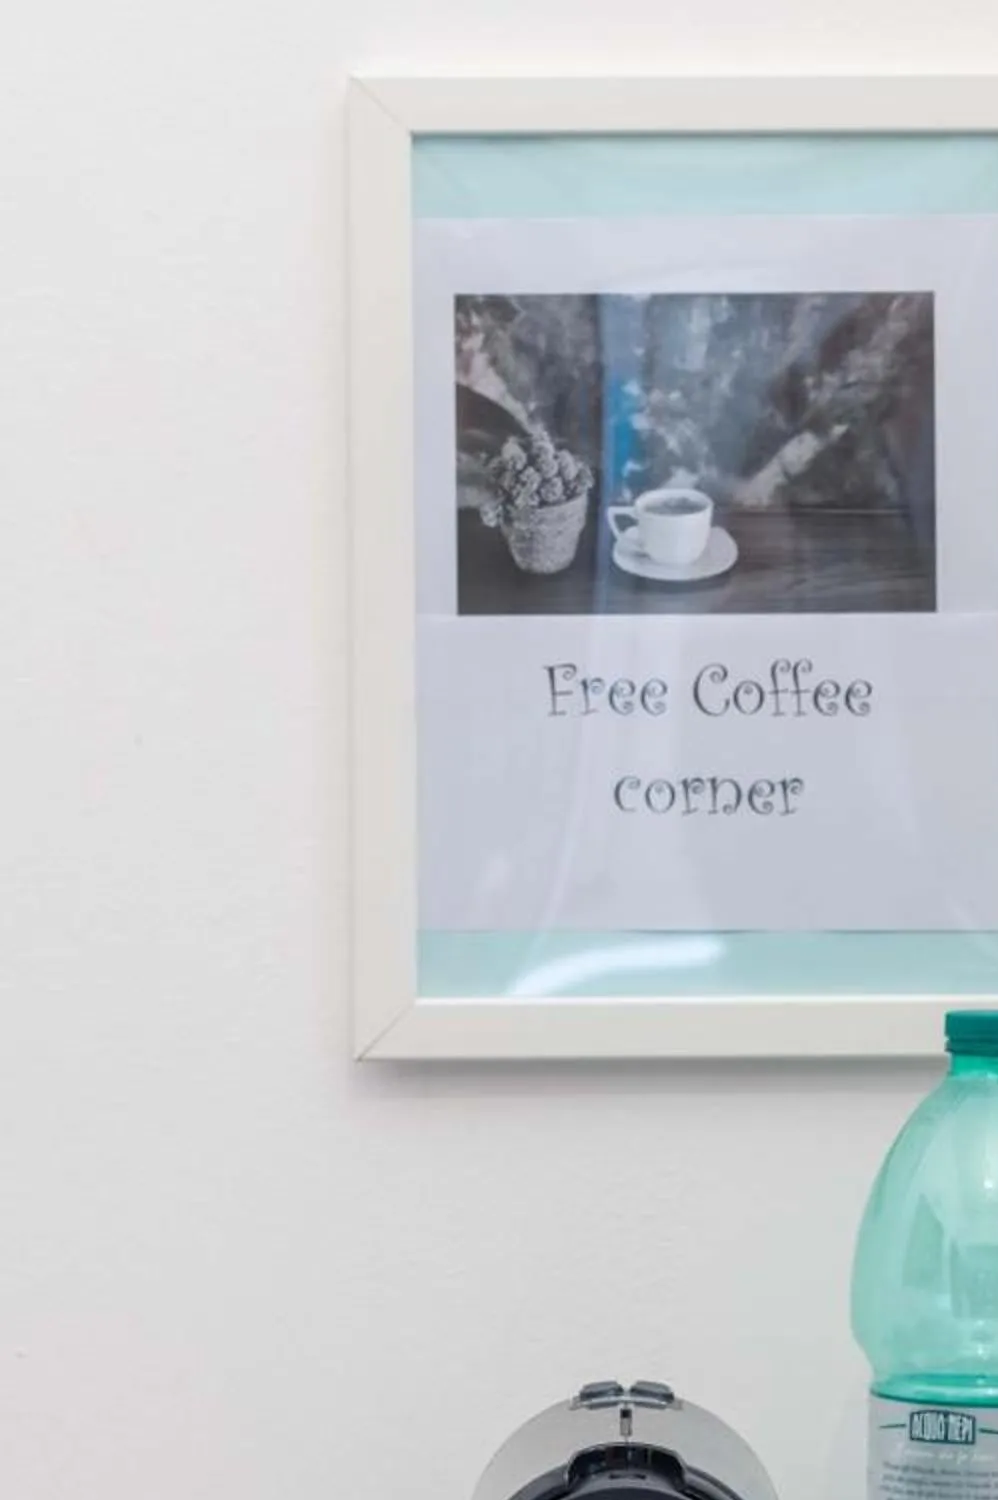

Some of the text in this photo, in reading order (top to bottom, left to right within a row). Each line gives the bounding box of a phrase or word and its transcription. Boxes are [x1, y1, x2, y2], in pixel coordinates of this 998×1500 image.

[544, 658, 873, 717] Free Coffee
[613, 775, 804, 816] corner
